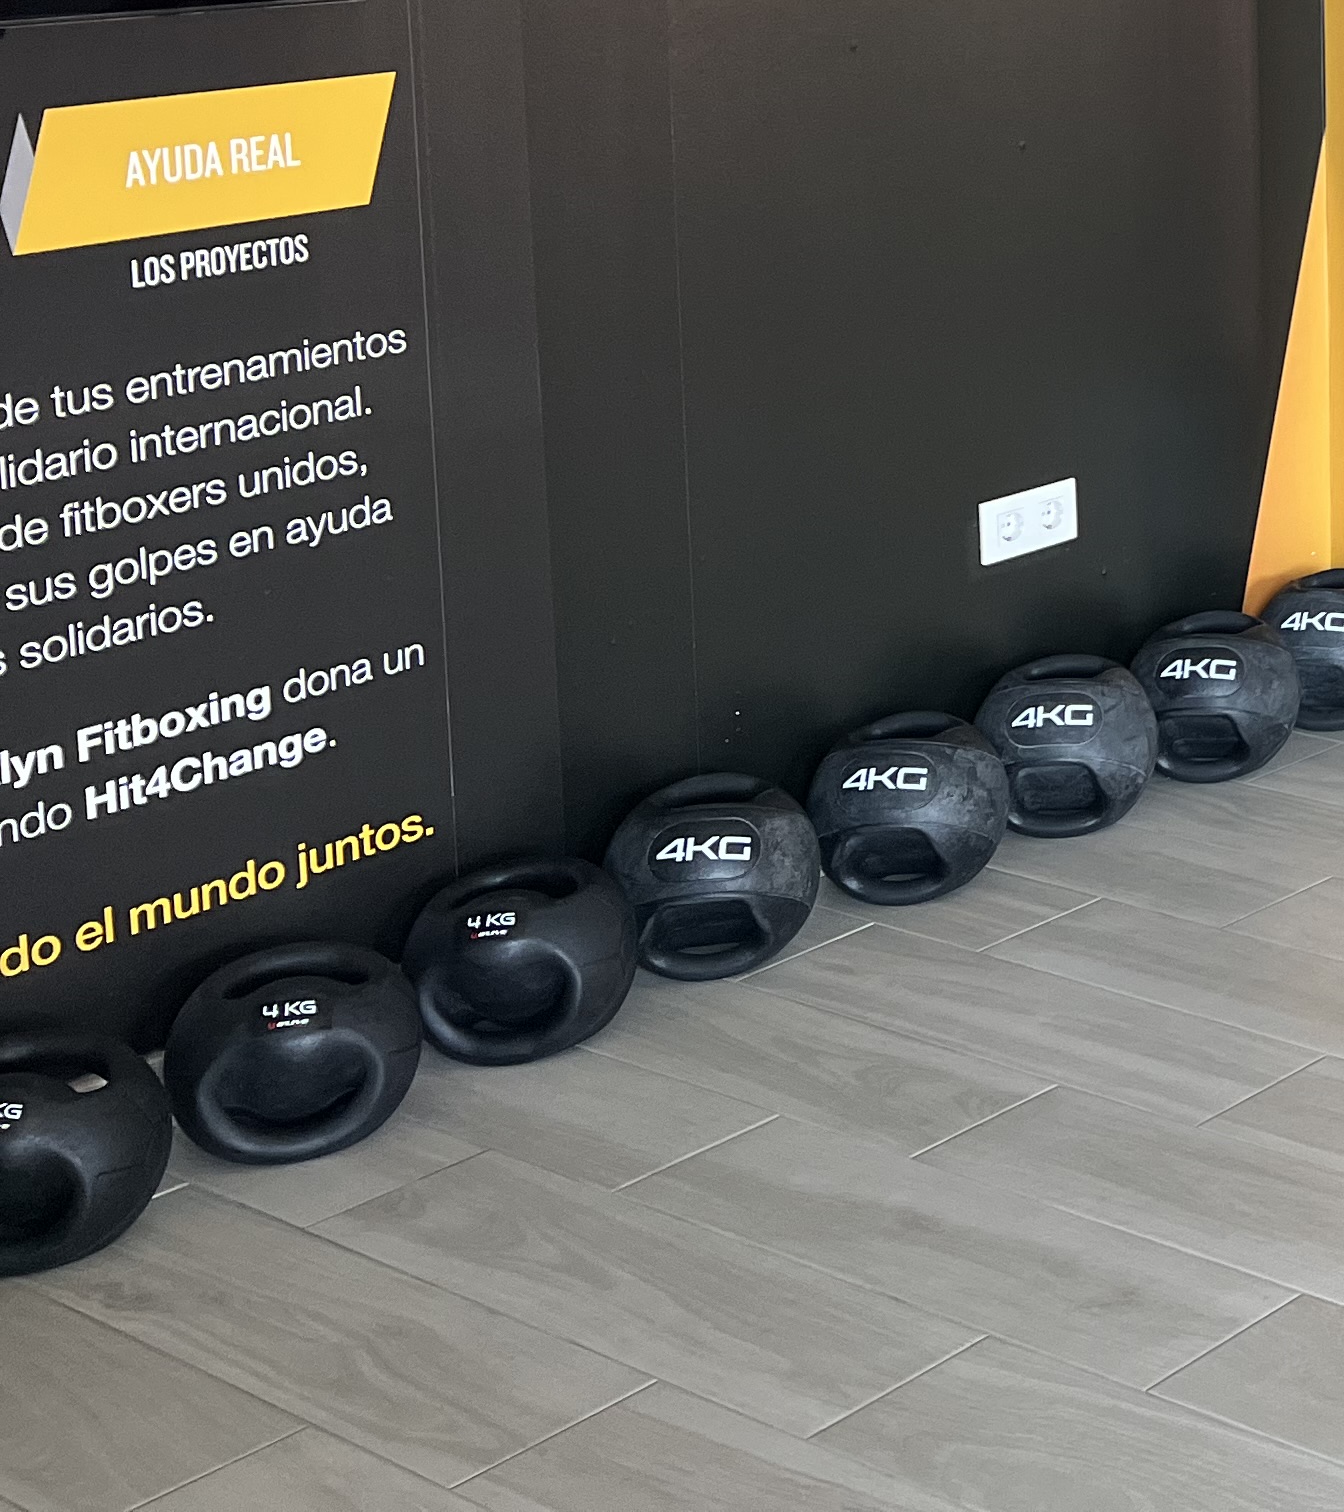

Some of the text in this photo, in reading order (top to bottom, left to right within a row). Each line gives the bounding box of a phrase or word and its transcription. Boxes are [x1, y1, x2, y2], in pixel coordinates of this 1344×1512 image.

[124, 132, 301, 189] AYUDA REAL
[130, 234, 310, 288] LOS PROYECTOS
[50, 384, 114, 418] tus
[126, 330, 407, 404] entrenamientos
[130, 386, 372, 463] internacional.
[0, 451, 368, 551] de fitboxers unidos,
[5, 495, 394, 611] sus golpes en ayuda
[20, 601, 214, 669] solidarios.
[1160, 657, 1237, 681] 4KG
[77, 686, 272, 763] Fitboxing
[283, 659, 373, 703] dona
[384, 644, 425, 676] un
[1011, 703, 1094, 729] 4KG
[85, 728, 337, 820] Hit4Change.
[842, 766, 928, 791] 4KG
[656, 835, 752, 863] 4KG
[0, 815, 435, 977] do el mundo juntos.
[467, 912, 516, 929] 4 KG
[262, 999, 318, 1019] 4 KG
